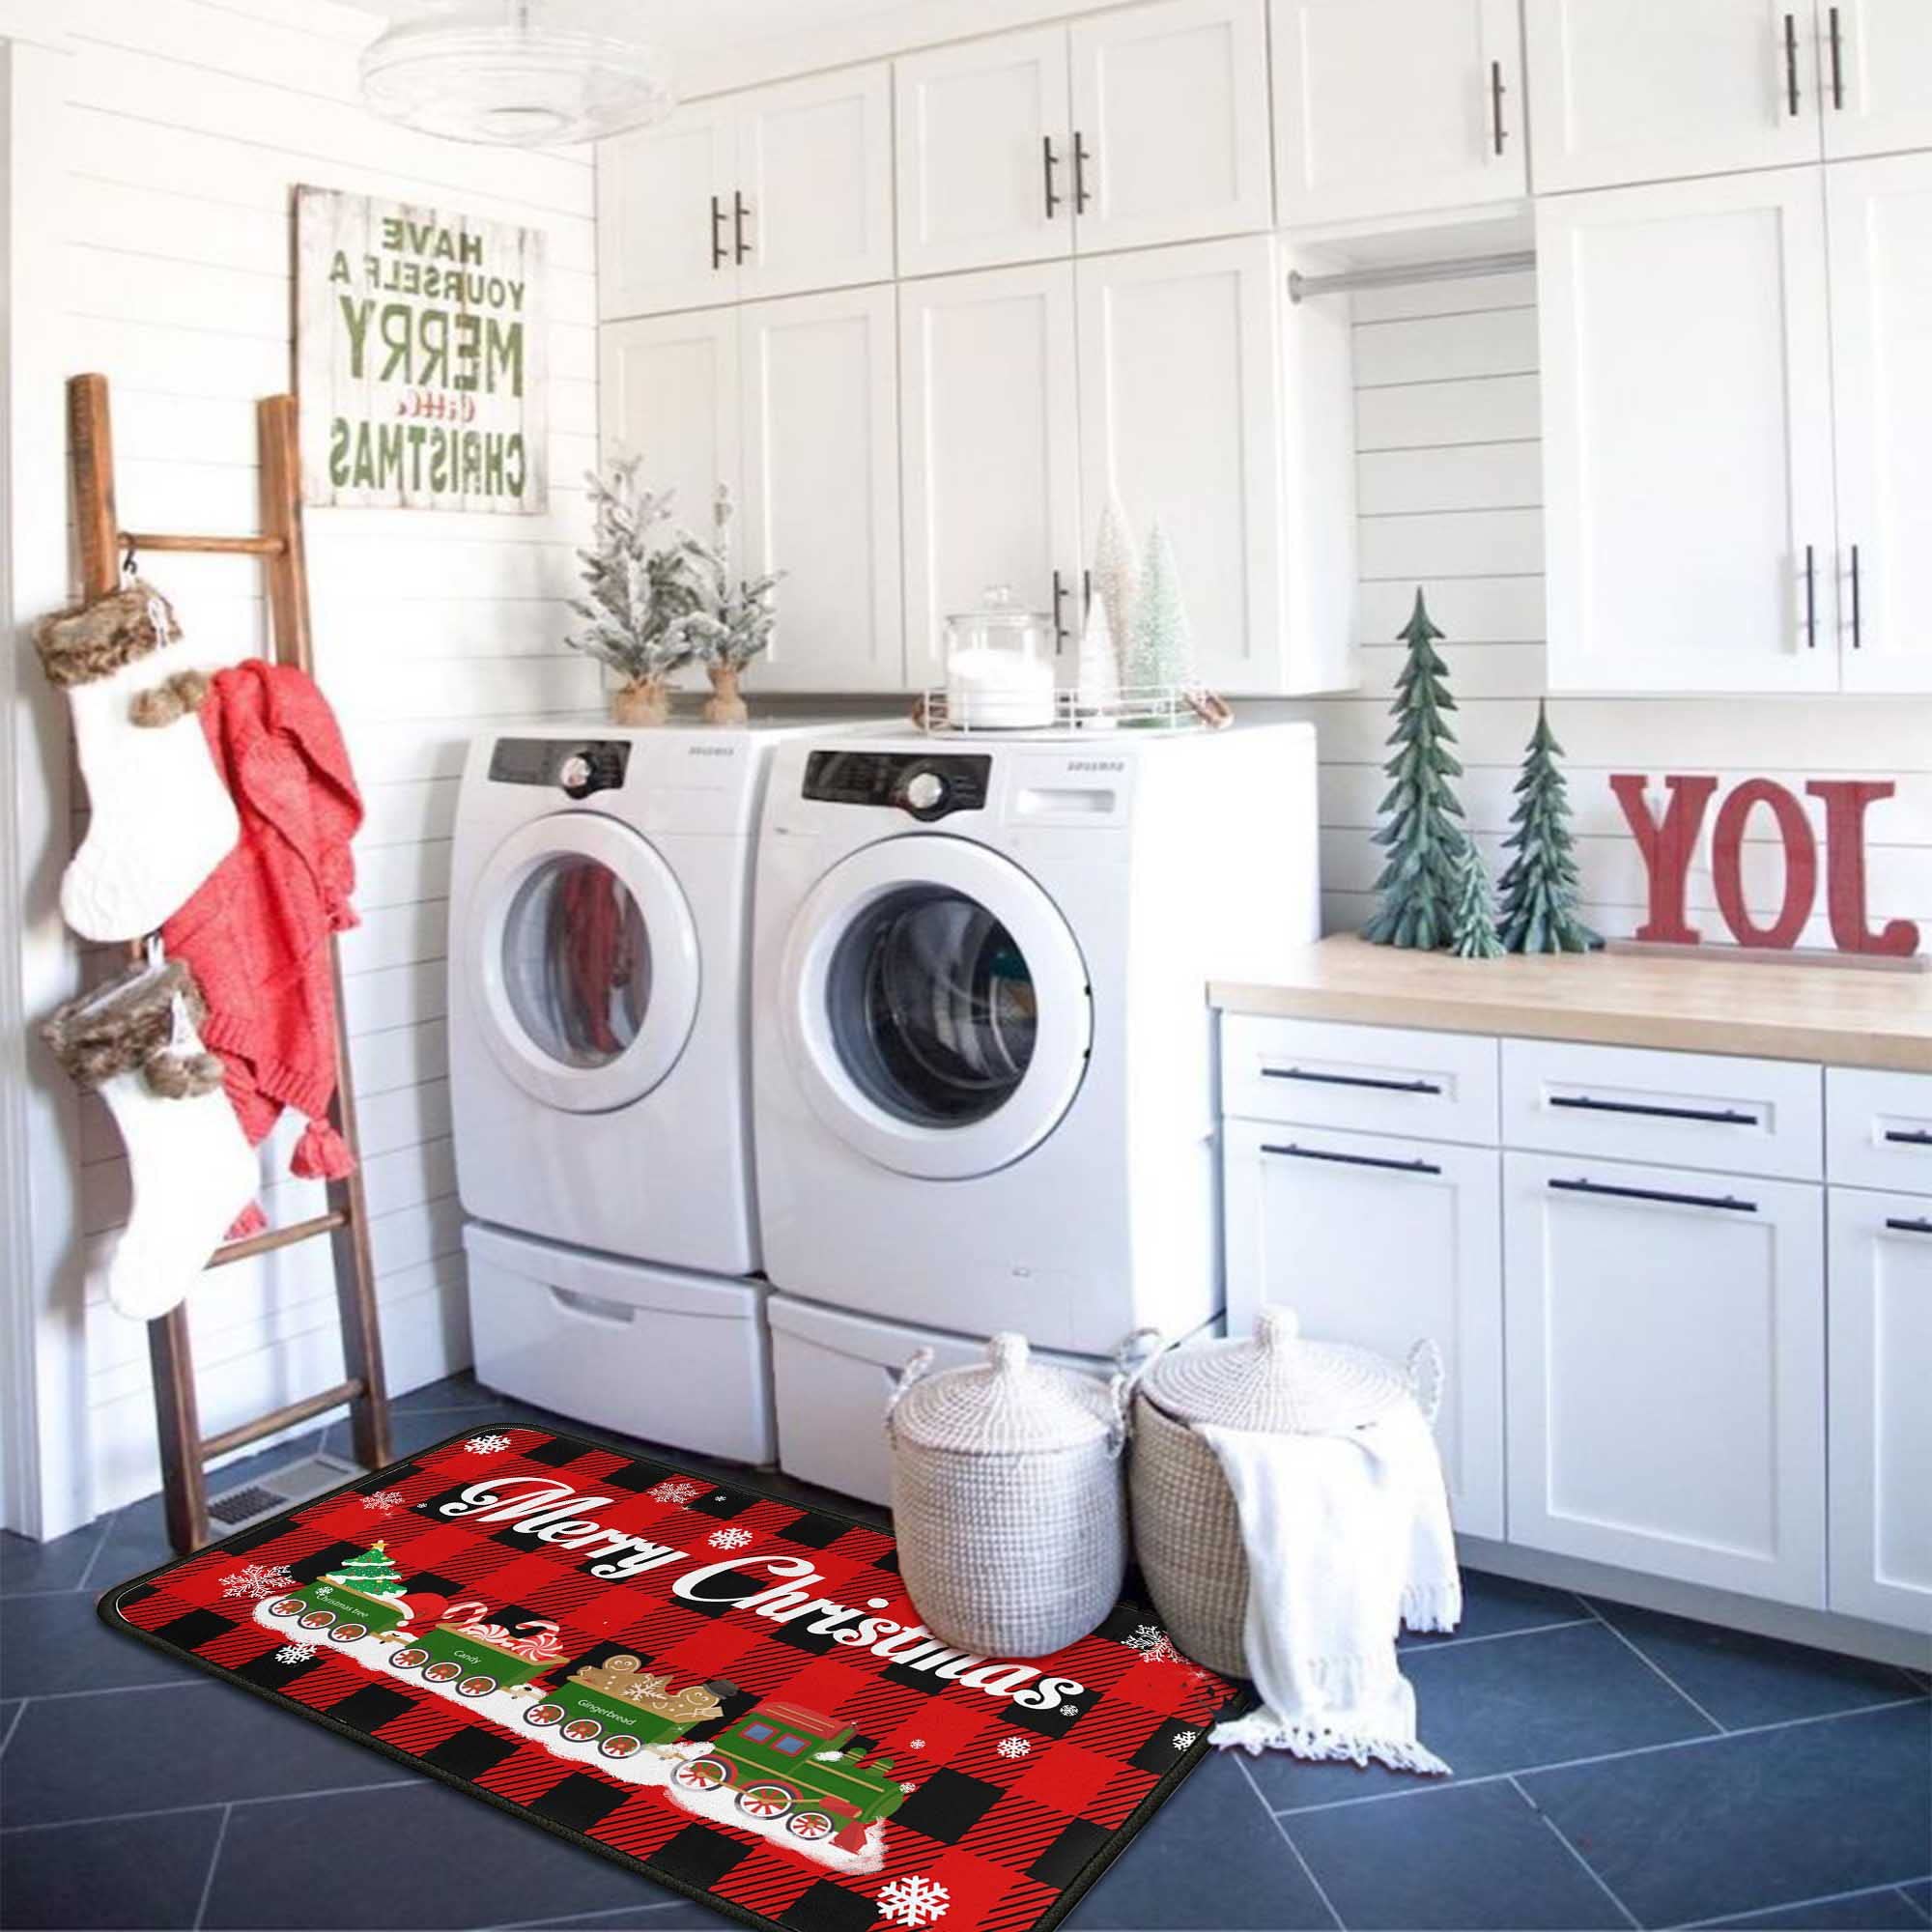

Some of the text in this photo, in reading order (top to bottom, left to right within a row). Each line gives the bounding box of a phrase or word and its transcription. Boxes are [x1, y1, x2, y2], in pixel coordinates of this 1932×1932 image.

[439, 1477, 1084, 1710] Merry Christmas
[351, 1608, 369, 1618] tree
[454, 1650, 482, 1664] Candy
[578, 1699, 638, 1726] Gingerbread
